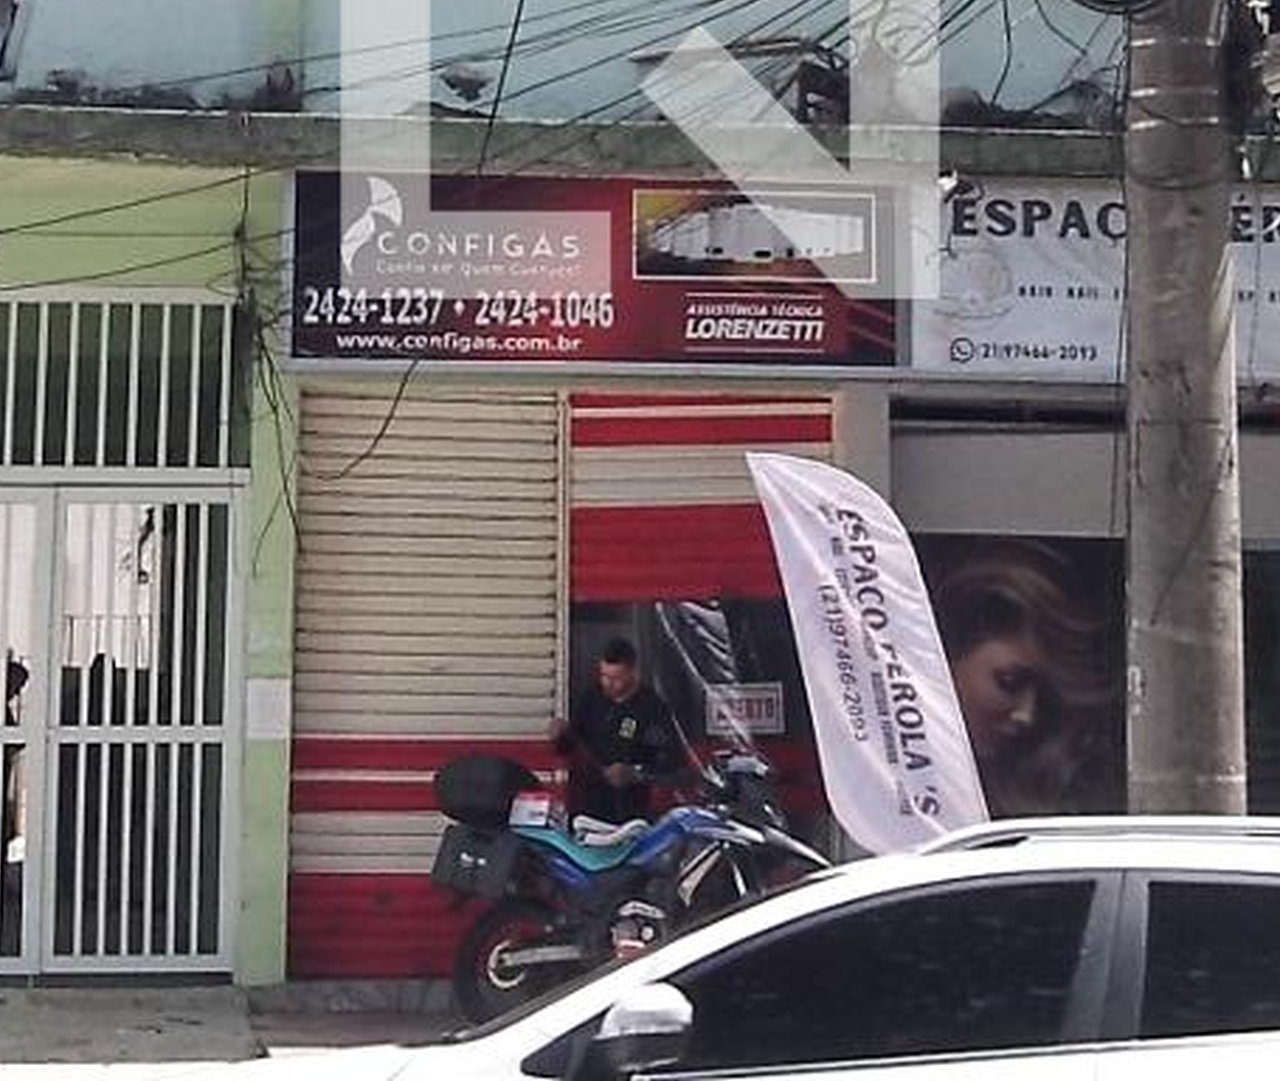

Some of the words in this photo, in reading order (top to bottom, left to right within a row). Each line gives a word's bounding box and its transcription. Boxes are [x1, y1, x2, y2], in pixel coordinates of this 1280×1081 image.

[952, 199, 1127, 247] ESPAÇ
[377, 232, 580, 258] CONFIGAS
[303, 287, 444, 324] 2424-1237
[474, 290, 615, 328] 2424-1046
[336, 332, 583, 353] www.configas.com.br
[685, 318, 825, 341] LORENZETTI
